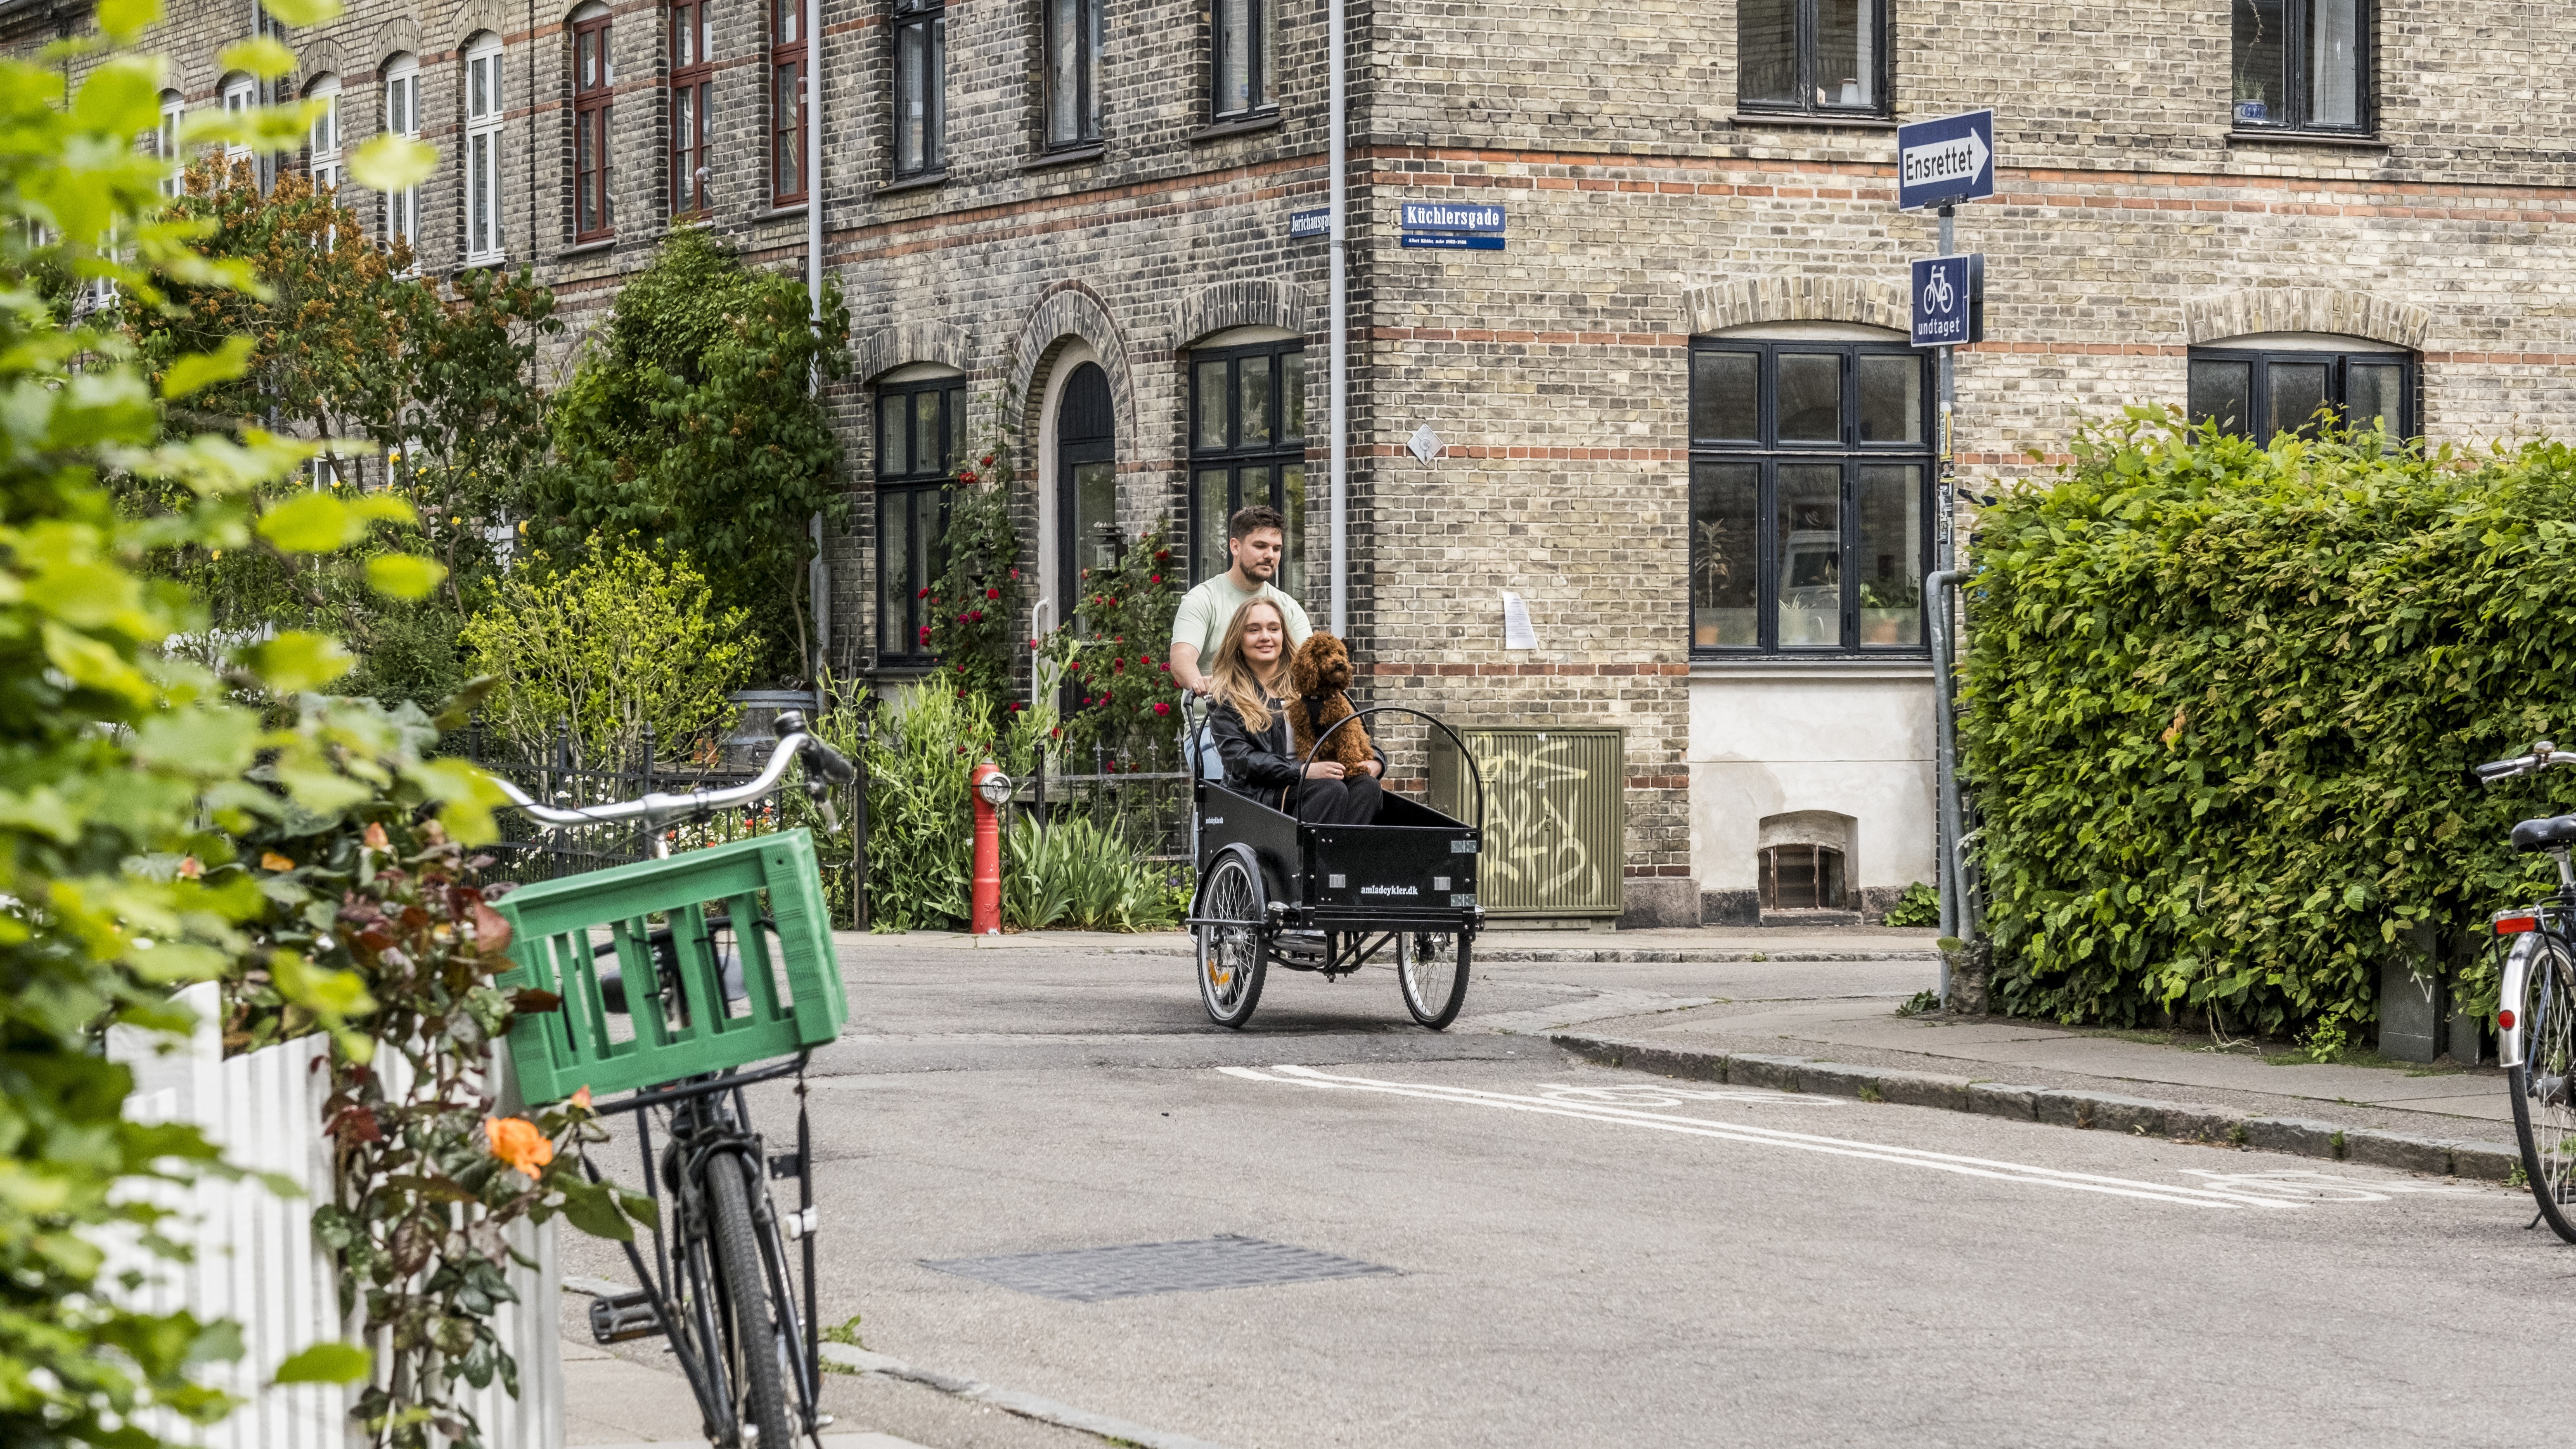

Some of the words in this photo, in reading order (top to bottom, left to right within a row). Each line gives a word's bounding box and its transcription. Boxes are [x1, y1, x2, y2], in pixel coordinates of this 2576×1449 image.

[1906, 143, 1973, 181] Ensrettet
[1407, 206, 1499, 228] Küchlersgade
[1918, 316, 1960, 336] undtaget
[1361, 885, 1418, 896] amladcykler.dk
